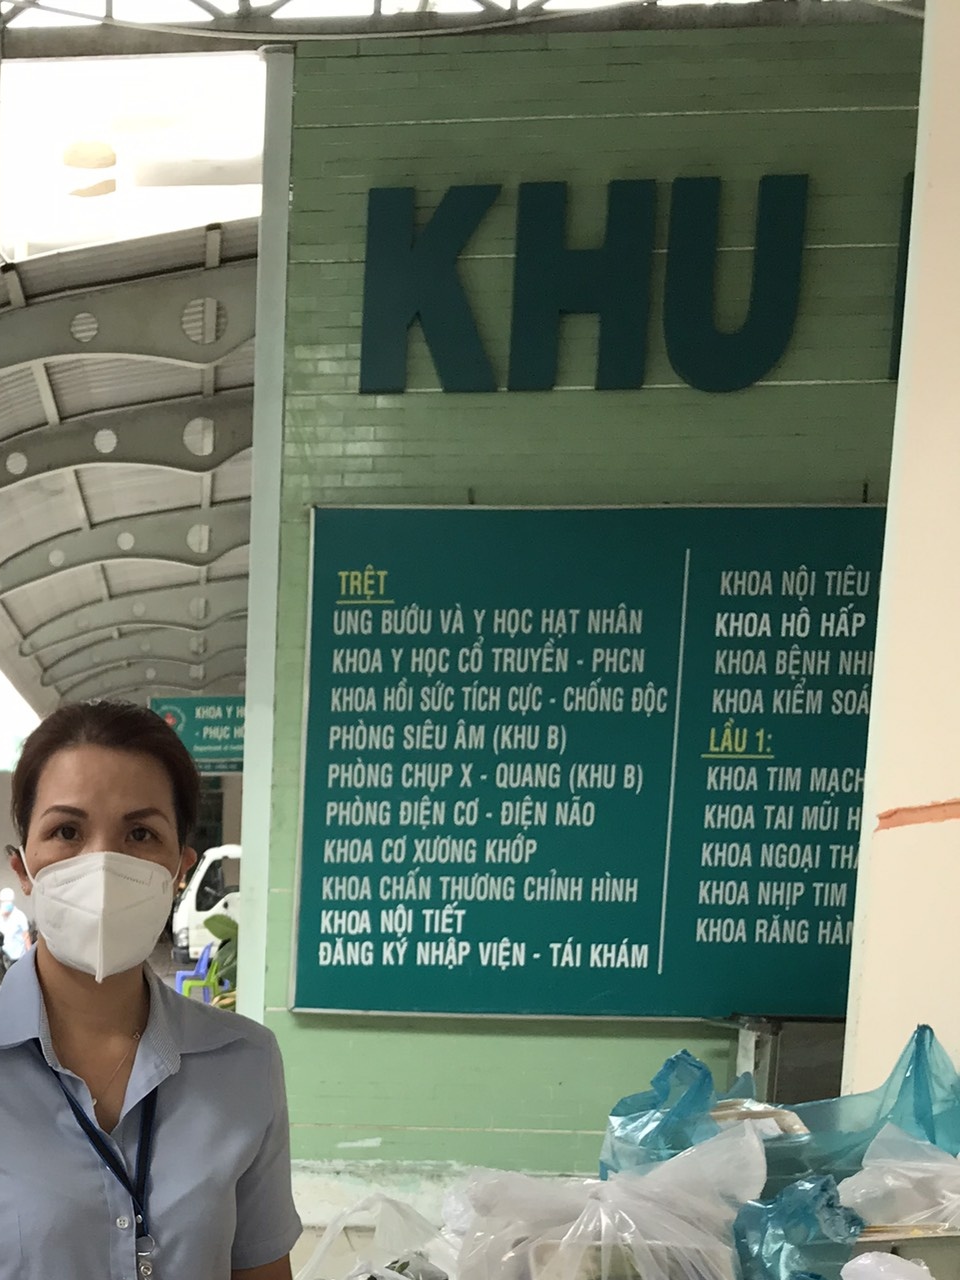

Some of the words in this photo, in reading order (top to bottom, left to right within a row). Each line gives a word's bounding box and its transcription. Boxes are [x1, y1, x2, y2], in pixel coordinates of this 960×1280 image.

[359, 174, 809, 393] KHU
[338, 564, 388, 600] TRỆT
[721, 571, 772, 596] KHOA
[782, 565, 815, 600] NỘI
[825, 565, 870, 595] TIÊU
[334, 610, 372, 635] UNG
[382, 603, 432, 634] BƯỚU
[440, 604, 464, 633] VÀ
[474, 610, 485, 633] Y
[494, 609, 532, 638] HỌC
[542, 609, 580, 638] HẠT
[588, 603, 642, 633] NHÂN
[716, 613, 771, 637] KHOA
[781, 607, 810, 637] HÔ
[820, 604, 865, 636] HẤP
[333, 648, 382, 673] KHOA
[392, 648, 403, 672] Y
[411, 648, 450, 677] HỌC
[458, 636, 484, 672] CỔ
[492, 638, 568, 672] TRUYỀN
[592, 648, 644, 673] PHCN
[715, 650, 766, 674] KHOA
[776, 644, 830, 679] BỆNH
[195, 706, 223, 719] KHOA
[332, 687, 376, 712] KHOA
[384, 678, 413, 711] HỒI
[420, 681, 454, 711] SỨC
[462, 681, 500, 711] TÍCH
[508, 684, 542, 715] CỰC
[564, 678, 624, 712] CHỐNG
[632, 682, 667, 717] ĐỘC
[712, 689, 764, 713] KHOA
[773, 678, 822, 714] KIỂM
[330, 720, 394, 750] PHÒNG
[403, 719, 447, 750] SIÊU
[454, 719, 484, 749] ÂM
[494, 725, 539, 754] (KHU
[547, 725, 566, 754] B)
[710, 718, 747, 752] LẦU
[756, 729, 772, 752] 1:
[328, 758, 392, 788] PHÒNG
[402, 763, 453, 792] CHỤP
[460, 764, 472, 787] X
[496, 763, 560, 788] QUANG
[570, 764, 616, 793] (KHU
[624, 764, 642, 794] B)
[707, 766, 757, 791] KHOA
[767, 767, 801, 791] TIM
[326, 796, 390, 826] PHÒNG
[400, 795, 445, 830] ĐIỆN
[454, 798, 479, 826] CƠ
[501, 796, 547, 830] ĐIỆN
[556, 796, 594, 826] NÃO
[704, 805, 754, 829] KHOA
[764, 806, 793, 829] TAI
[802, 801, 838, 830] MŨI
[324, 839, 373, 863] KHOA
[382, 836, 406, 863] CƠ
[413, 836, 476, 863] XƯƠNG
[486, 833, 537, 863] KHỚP
[702, 843, 752, 867] KHOA
[761, 844, 820, 872] NGOẠI
[322, 876, 371, 900] KHOA
[380, 867, 431, 900] CHẤN
[440, 873, 515, 900] THƯƠNG
[524, 869, 582, 901] CHỈNH
[591, 872, 638, 902] HÌNH
[699, 881, 749, 905] KHOA
[758, 882, 804, 910] NHỊP
[813, 883, 846, 906] TIM
[321, 910, 371, 934] KHOA
[381, 904, 412, 937] NỘI
[422, 902, 466, 933] TIẾT
[696, 918, 746, 942] KHOA
[756, 915, 808, 944] RĂNG
[319, 938, 373, 966] ĐĂNG
[383, 937, 408, 965] KÝ
[417, 937, 470, 969] NHẬP
[479, 938, 525, 970] VIỆN
[550, 937, 581, 967] TÁI
[590, 938, 648, 968] KHÁM
